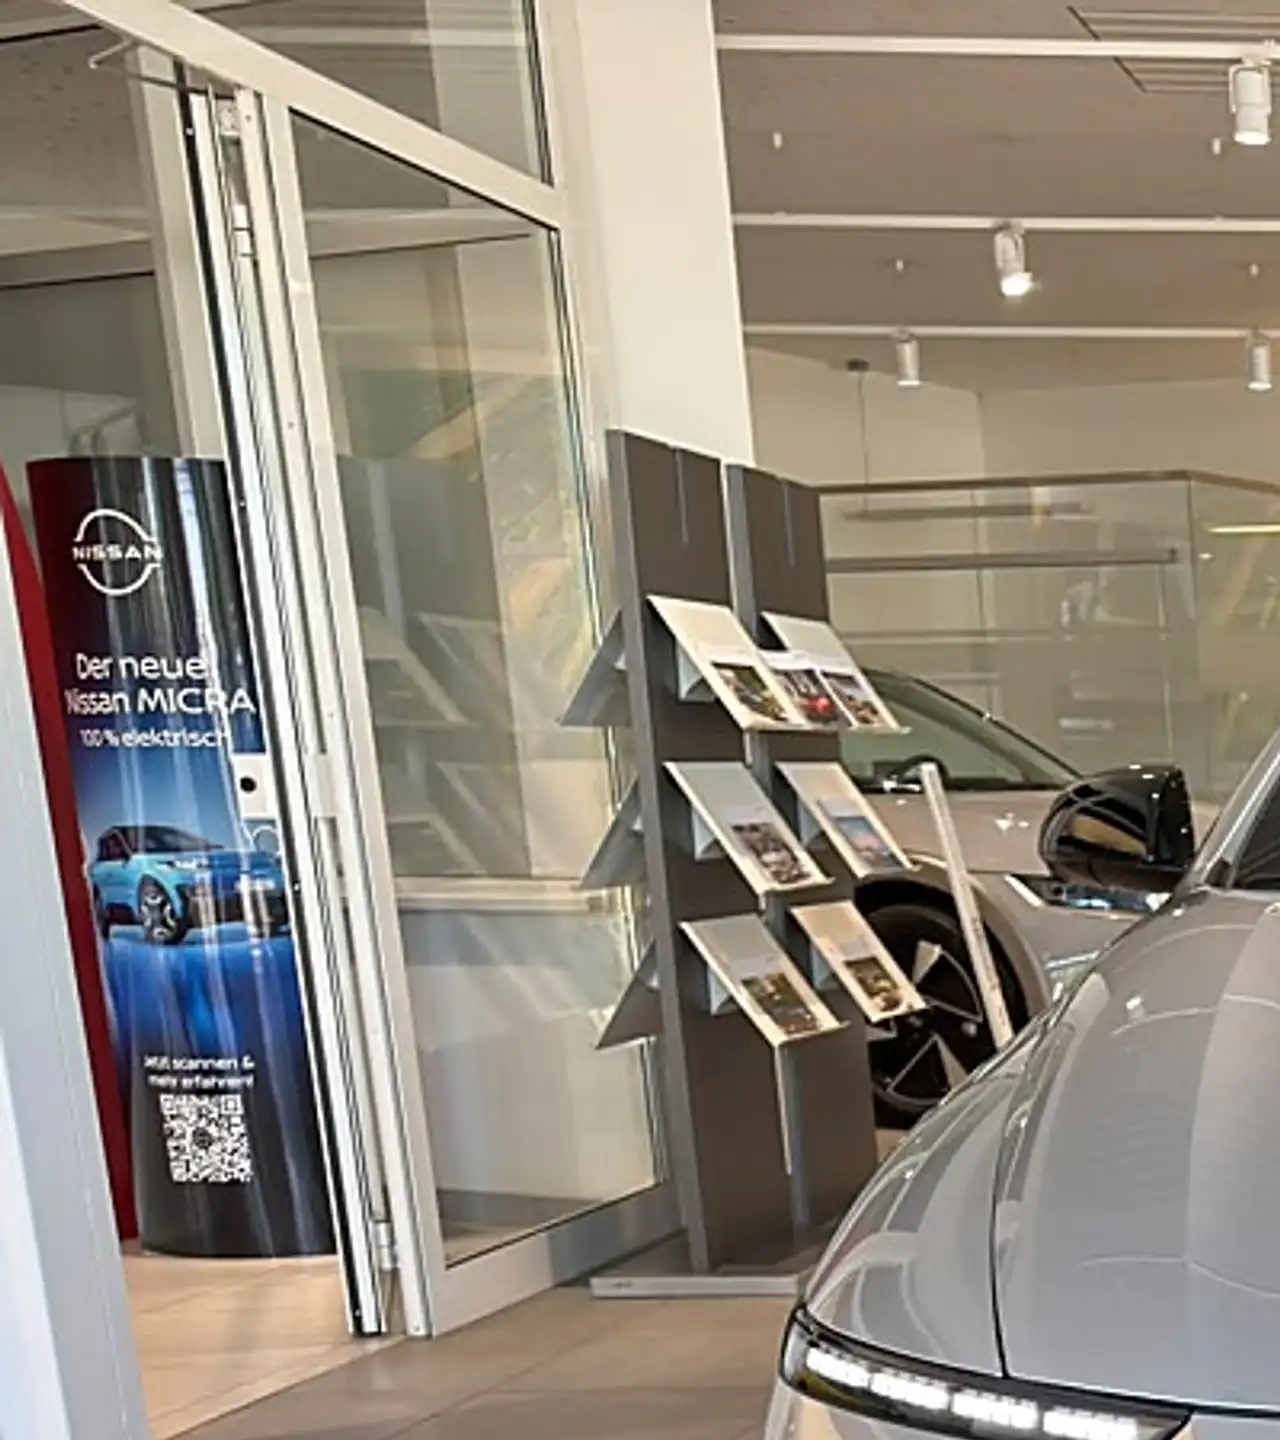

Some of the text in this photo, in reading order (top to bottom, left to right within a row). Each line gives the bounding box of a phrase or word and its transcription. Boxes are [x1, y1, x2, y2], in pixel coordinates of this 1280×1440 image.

[72, 543, 163, 561] NISSAN
[76, 653, 208, 680] Der neue
[65, 687, 256, 715] Nissan MICRA
